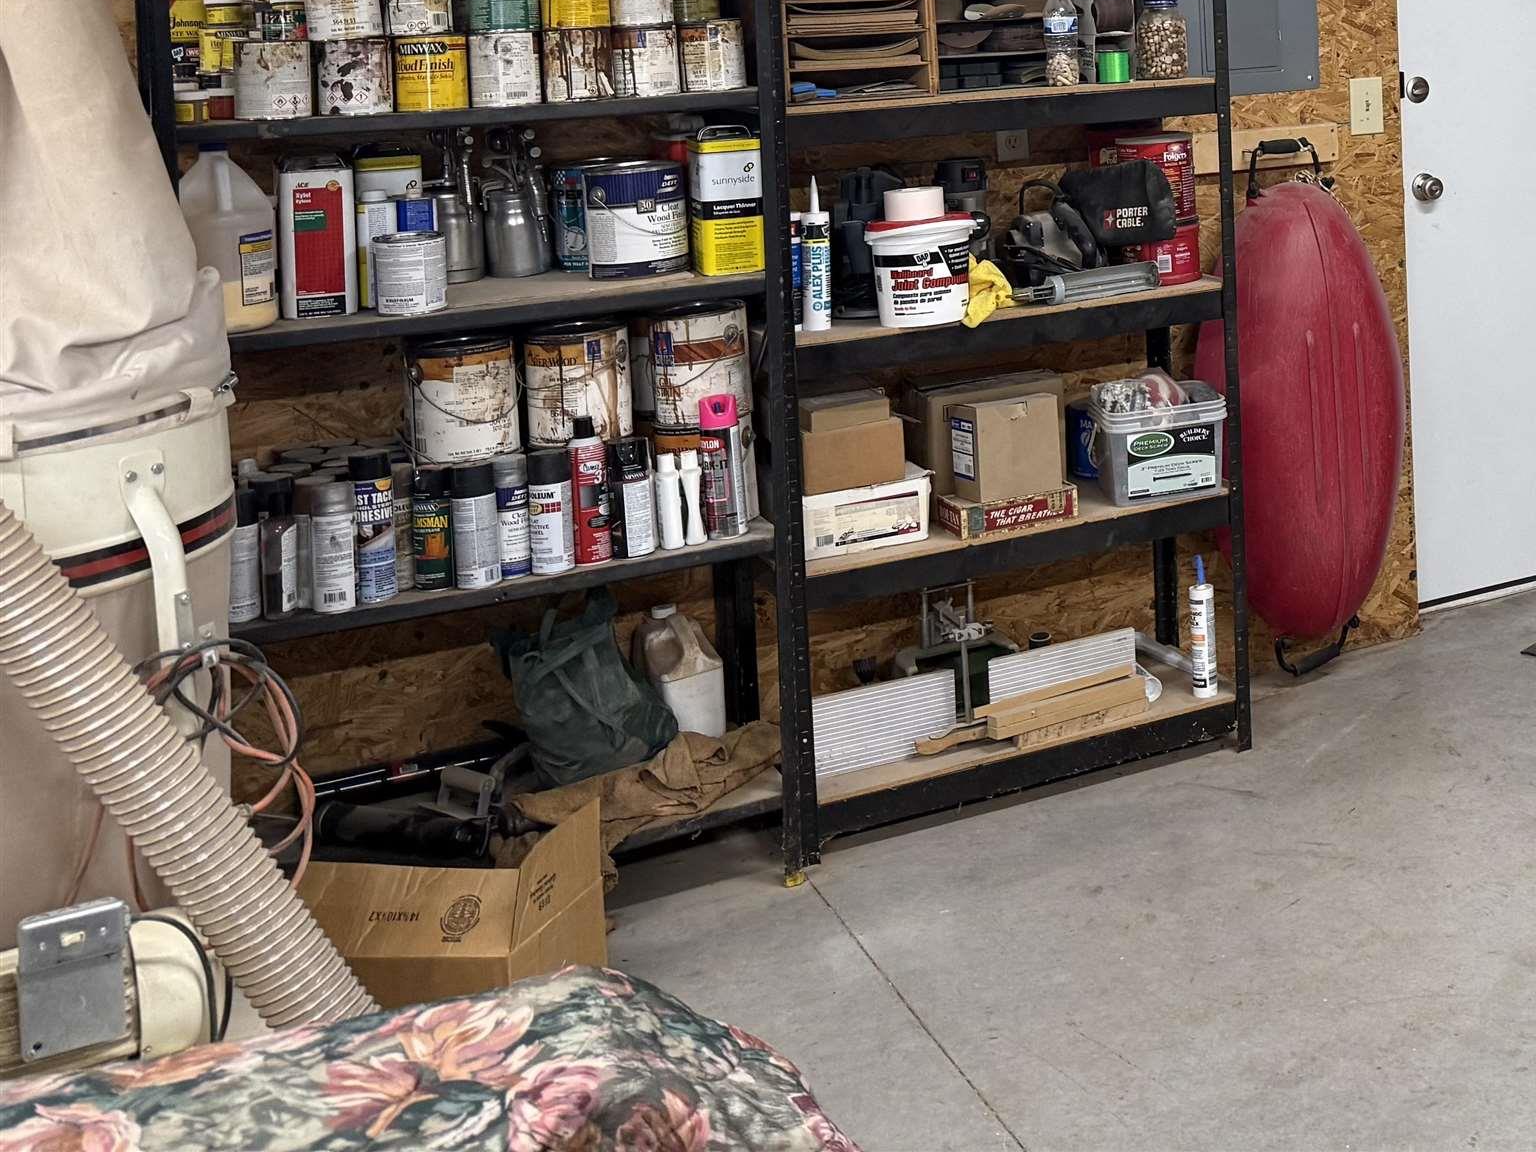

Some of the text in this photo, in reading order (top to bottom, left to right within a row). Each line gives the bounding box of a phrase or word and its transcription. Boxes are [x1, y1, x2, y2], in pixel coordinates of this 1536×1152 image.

[170, 17, 203, 29] Johnson
[399, 42, 443, 56] MINWAX
[399, 60, 418, 71] ood
[1163, 151, 1187, 162] Folgers
[712, 174, 755, 187] sunnyside
[661, 203, 679, 212] Clear
[713, 203, 735, 212] Lacquer
[1116, 206, 1148, 218] PORTER
[647, 212, 671, 223] Wood
[916, 252, 930, 263] DAP
[812, 246, 823, 299] ALEX PLUS
[891, 279, 920, 292] Joint
[1179, 428, 1210, 439] BUILDERS
[1182, 435, 1208, 443] CHOICE
[1133, 437, 1169, 447] PREMIUM
[372, 492, 393, 504] TACK
[355, 508, 393, 523] DHESIVE
[990, 504, 1034, 520] THE CIGAR
[996, 515, 1017, 527] THAT
